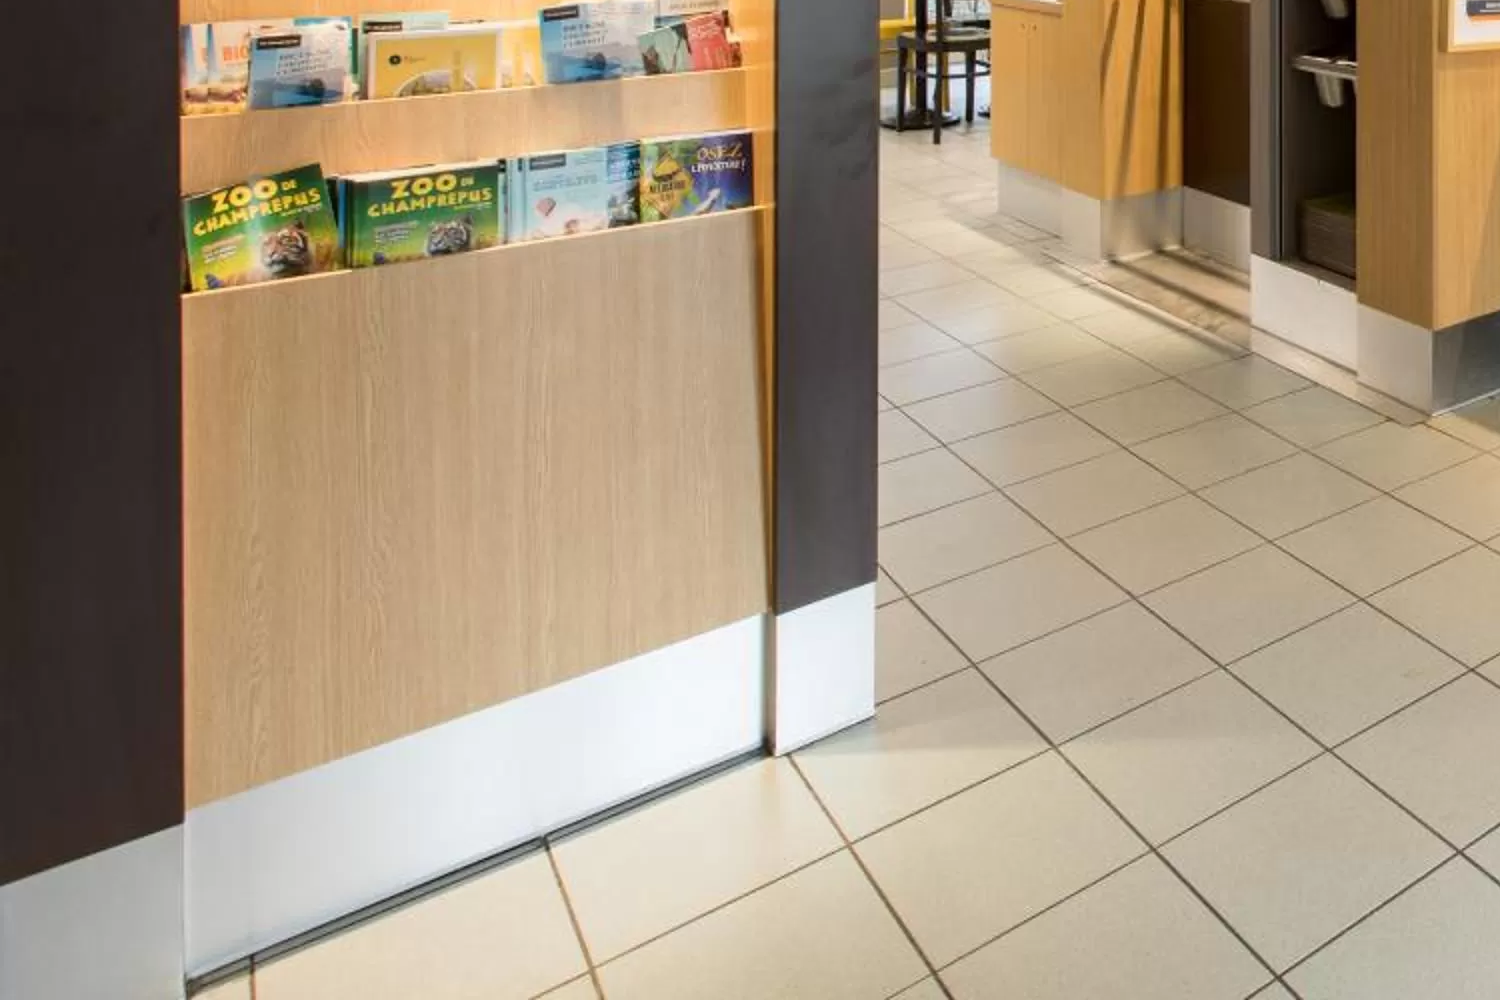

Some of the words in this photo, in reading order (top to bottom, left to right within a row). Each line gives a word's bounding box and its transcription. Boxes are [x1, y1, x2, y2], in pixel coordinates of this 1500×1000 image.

[212, 179, 278, 214] ZOO
[367, 187, 493, 217] CHAMPREPUS
[391, 173, 457, 199] ZOO
[192, 187, 321, 237] CHAMPREPUS
